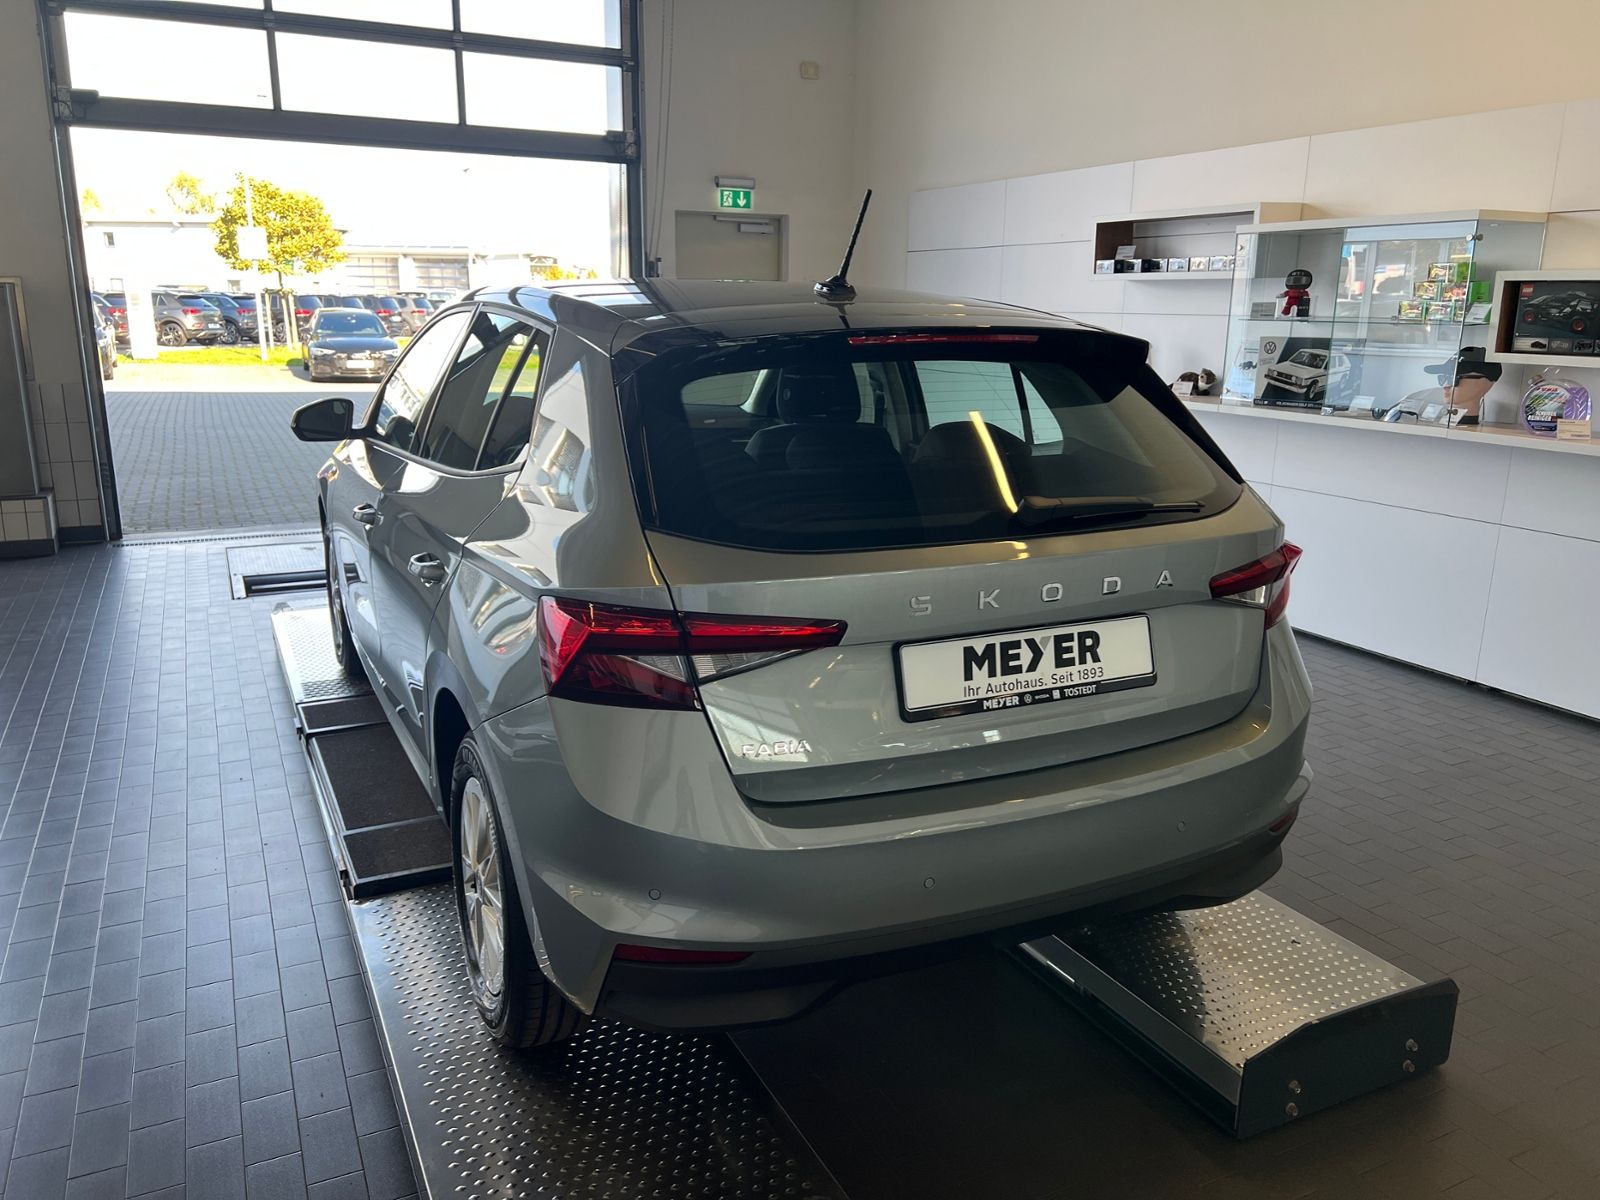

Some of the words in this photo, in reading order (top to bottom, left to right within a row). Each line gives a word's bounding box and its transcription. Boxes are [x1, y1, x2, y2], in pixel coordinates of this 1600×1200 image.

[910, 569, 1174, 616] SKODA
[963, 630, 1102, 682] MEYER
[963, 685, 981, 698] Ihr
[985, 678, 1048, 695] Autohaus.
[1051, 671, 1074, 685] Seit
[1077, 667, 1104, 681] 1893
[983, 695, 1020, 710] MEYER
[1063, 684, 1097, 697] TOSTEDT
[742, 739, 812, 758] FABIA
